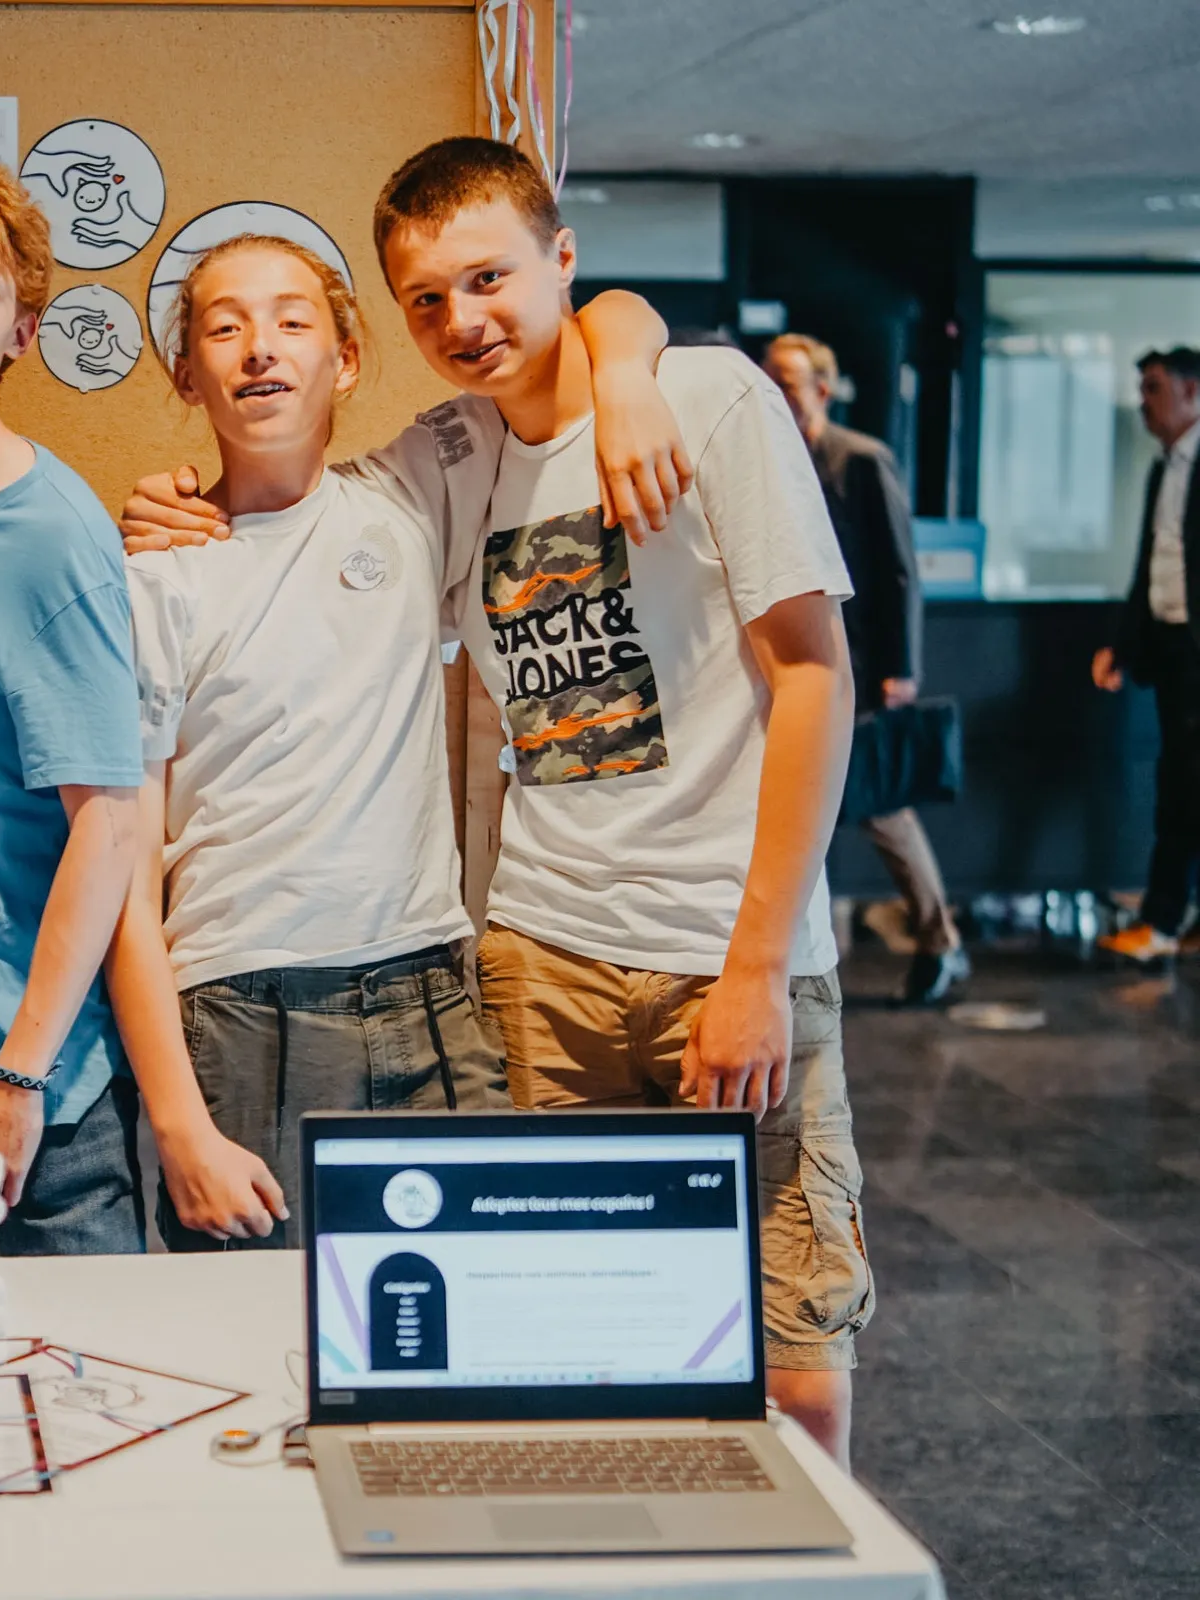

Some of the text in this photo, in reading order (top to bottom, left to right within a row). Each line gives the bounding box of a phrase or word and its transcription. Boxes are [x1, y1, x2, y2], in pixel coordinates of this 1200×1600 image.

[505, 641, 651, 706] JONES
[471, 1196, 528, 1215] Adoptez
[529, 1196, 559, 1212] tous
[560, 1197, 590, 1212] mes
[591, 1193, 644, 1214] copains
